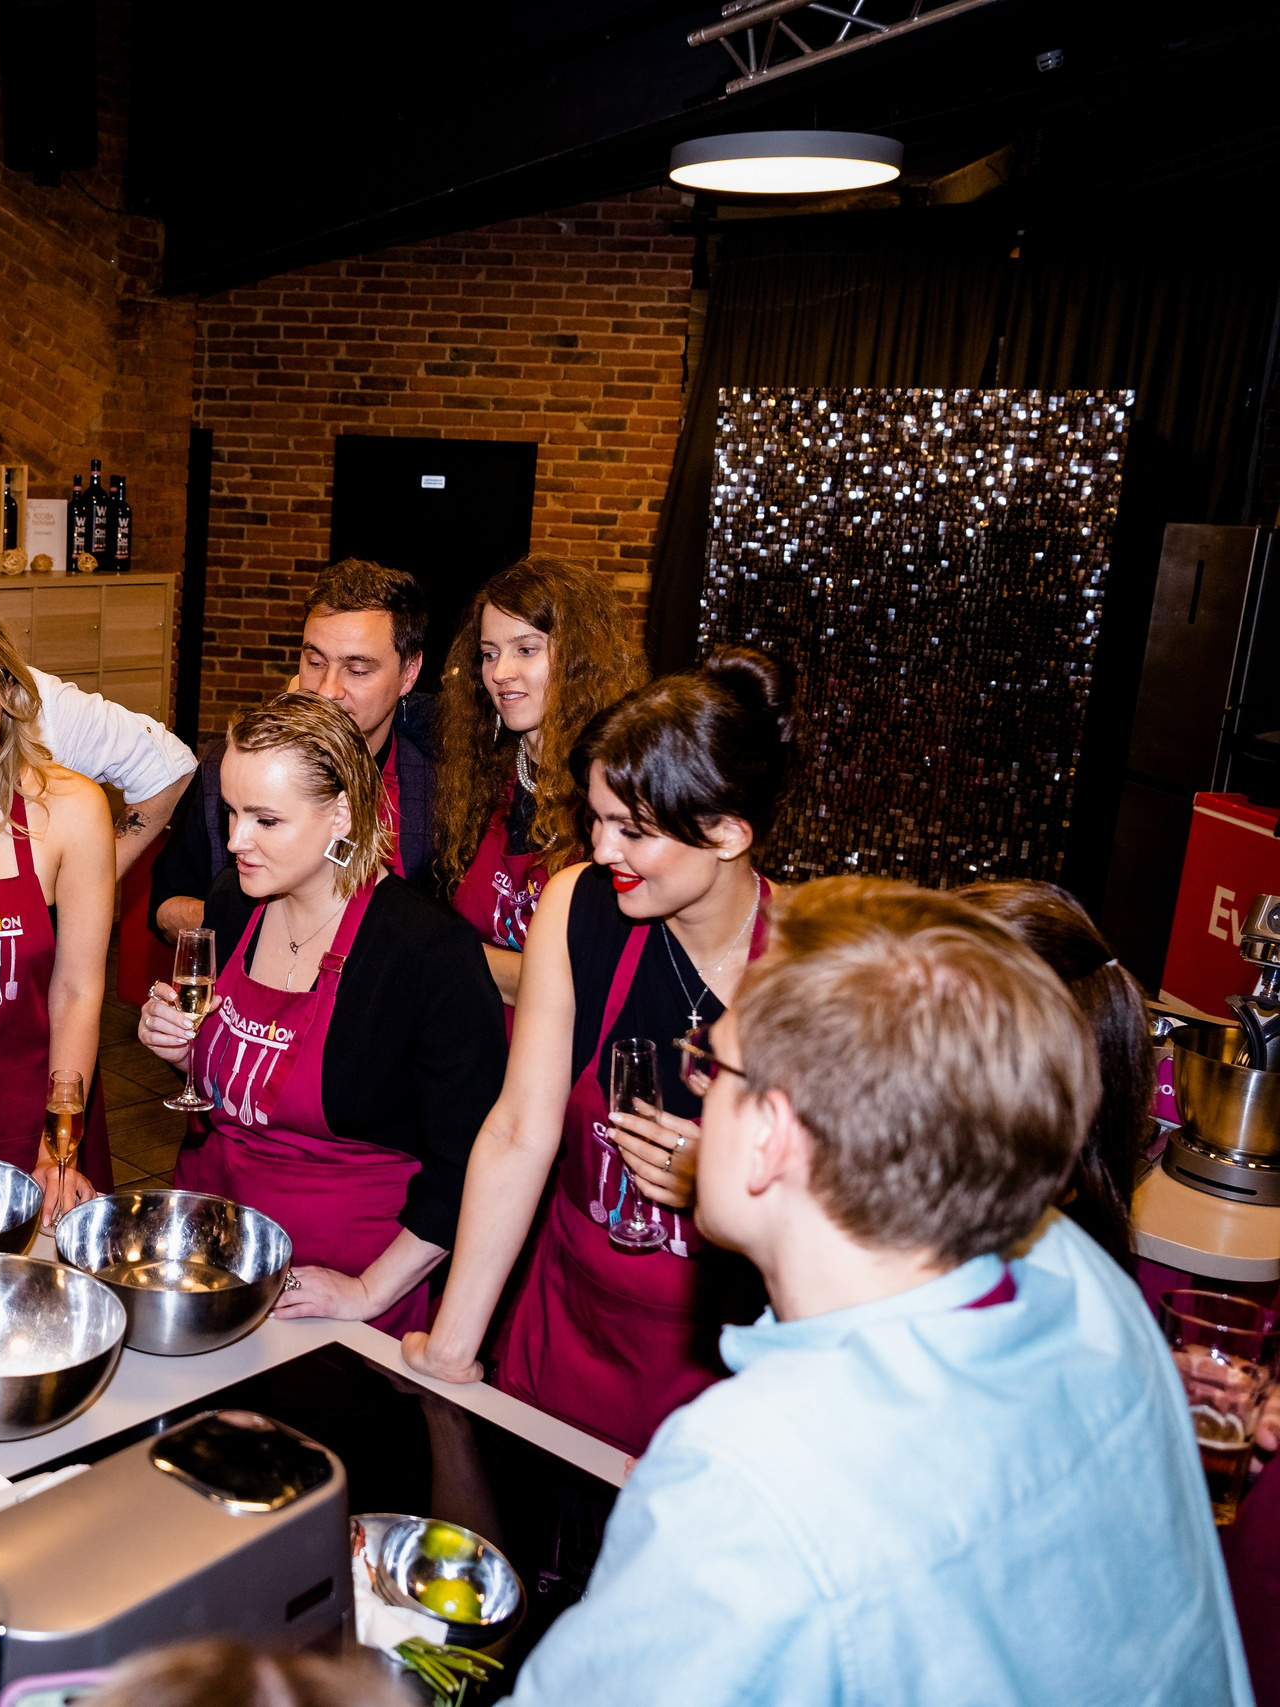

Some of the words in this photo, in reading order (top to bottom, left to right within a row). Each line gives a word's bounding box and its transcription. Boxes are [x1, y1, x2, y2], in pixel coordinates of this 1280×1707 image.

[96, 506, 107, 517] W
[75, 516, 86, 526] W
[118, 517, 129, 527] W
[223, 995, 297, 1043] CUNARYON
